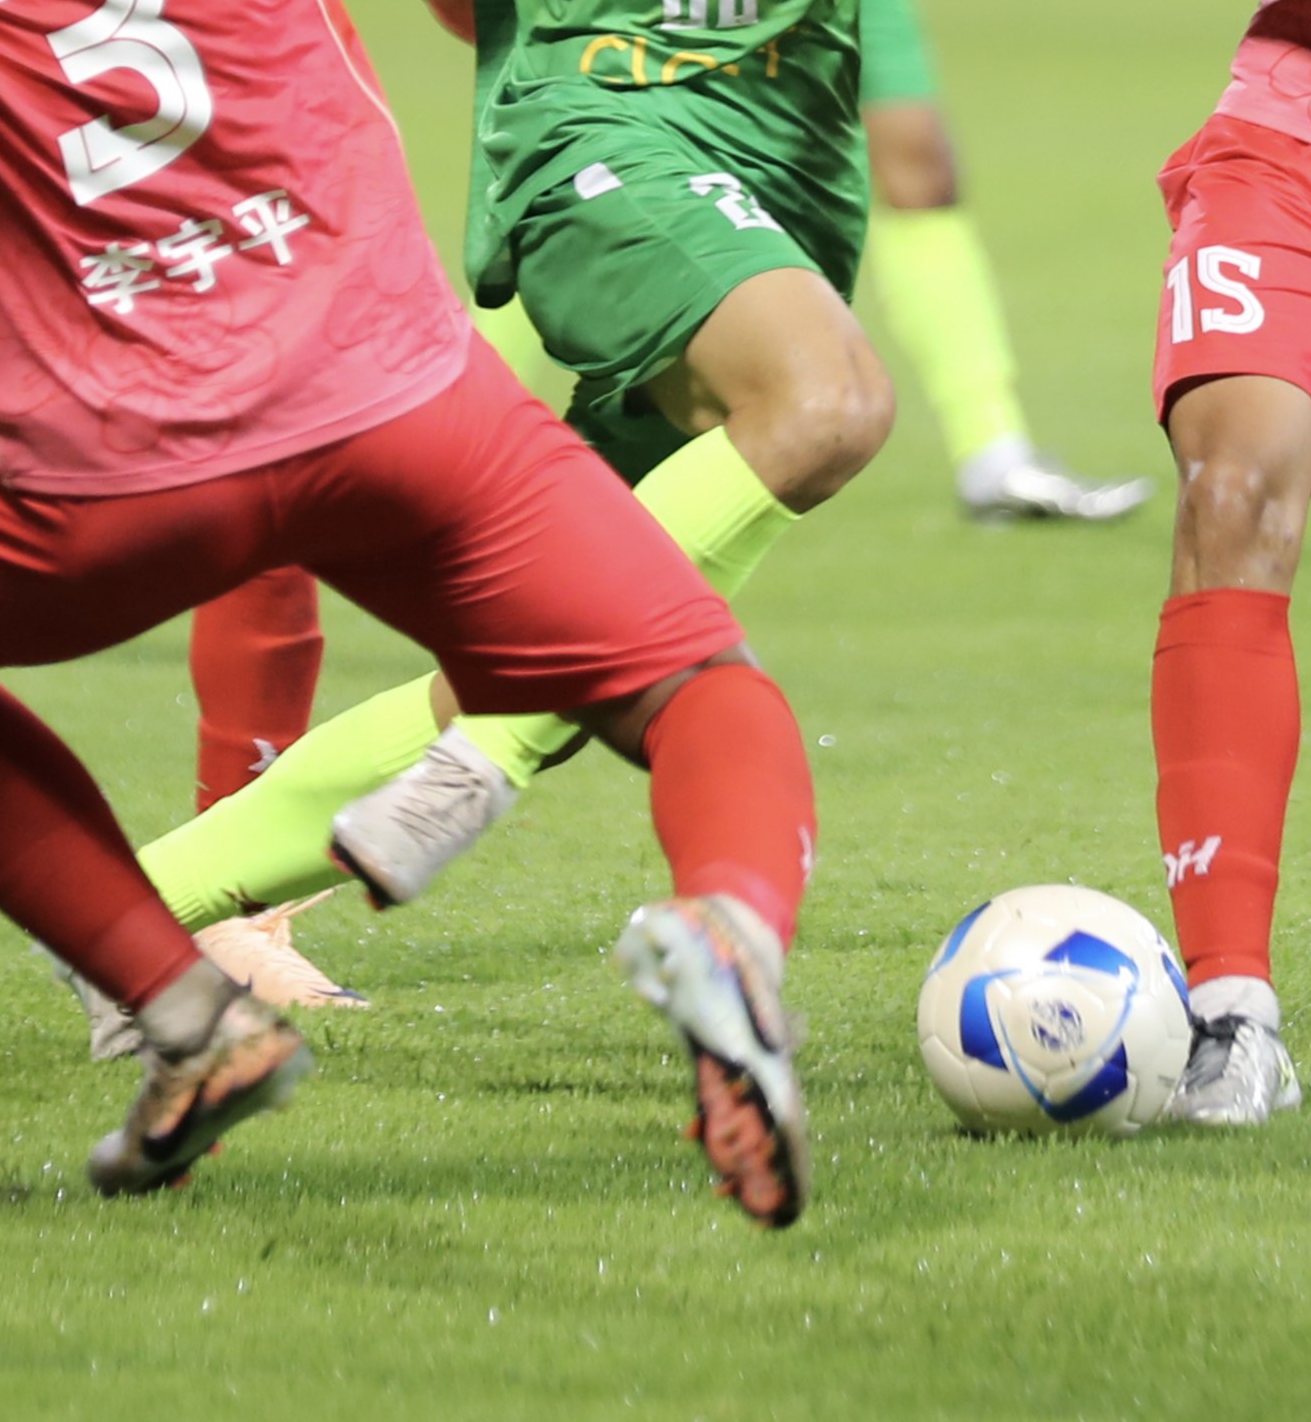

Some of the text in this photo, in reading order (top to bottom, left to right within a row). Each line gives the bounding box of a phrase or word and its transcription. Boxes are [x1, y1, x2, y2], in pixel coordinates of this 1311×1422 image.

[79, 189, 310, 313] 李宇平
[1167, 245, 1265, 343] 15
